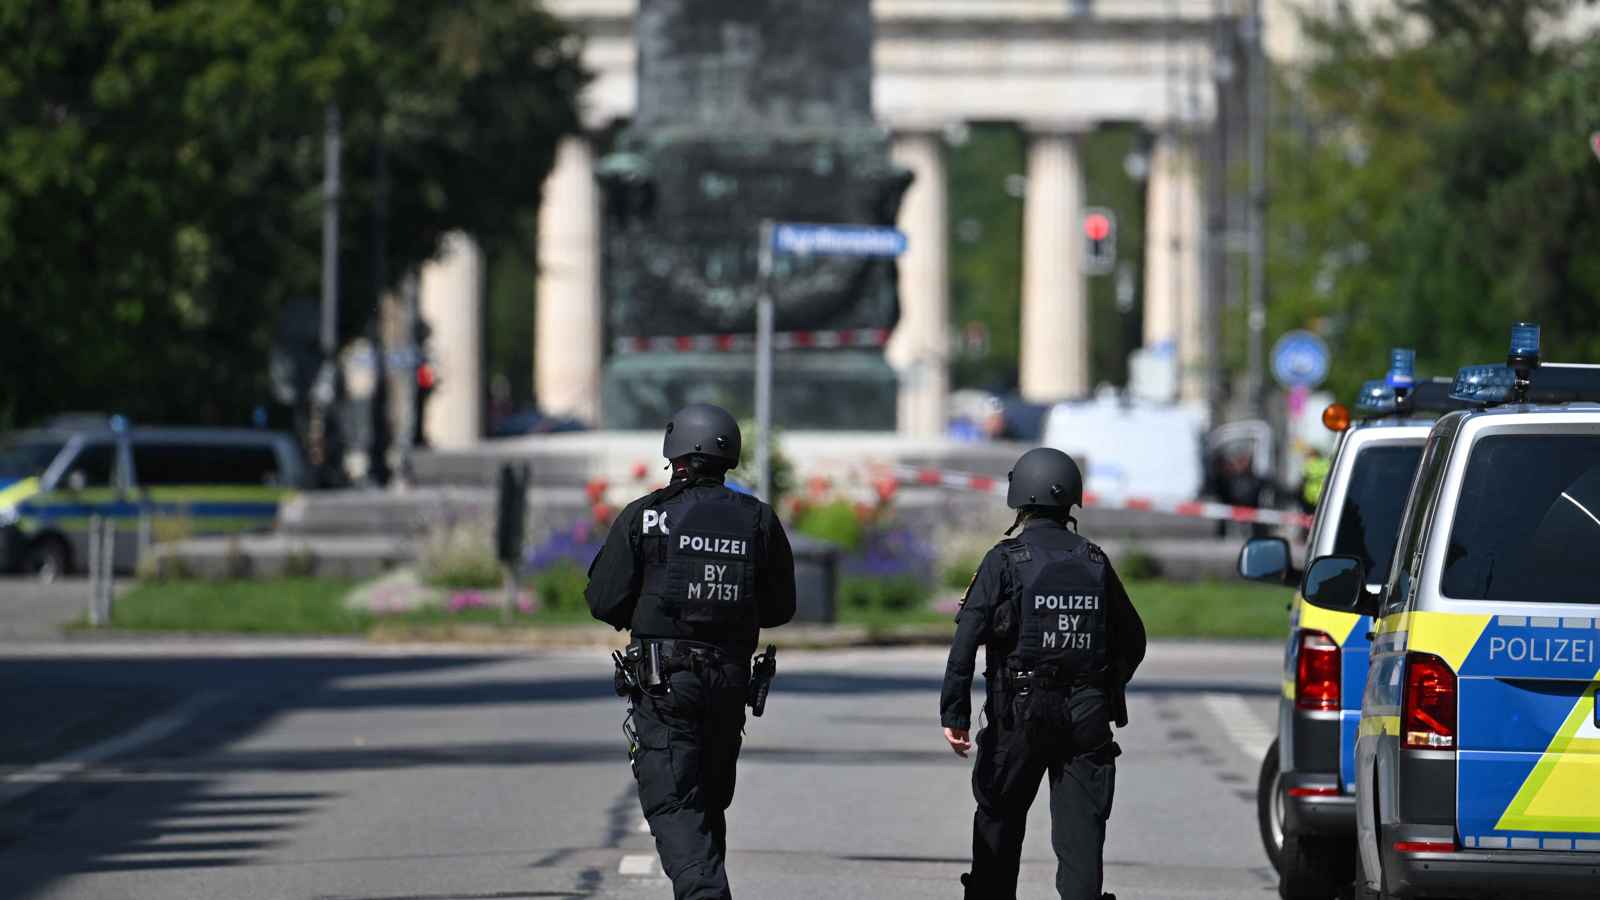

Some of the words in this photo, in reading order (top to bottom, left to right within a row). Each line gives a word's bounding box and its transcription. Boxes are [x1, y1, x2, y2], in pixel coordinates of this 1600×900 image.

[679, 535, 746, 555] POLIZEI
[704, 565, 727, 582] BY
[687, 582, 701, 600] M
[706, 583, 739, 601] 7131
[1034, 595, 1099, 610] POLIZEI
[1058, 614, 1081, 631] BY
[1042, 631, 1056, 648] M
[1061, 632, 1091, 649] 7131
[1489, 636, 1594, 663] POLIZEI
